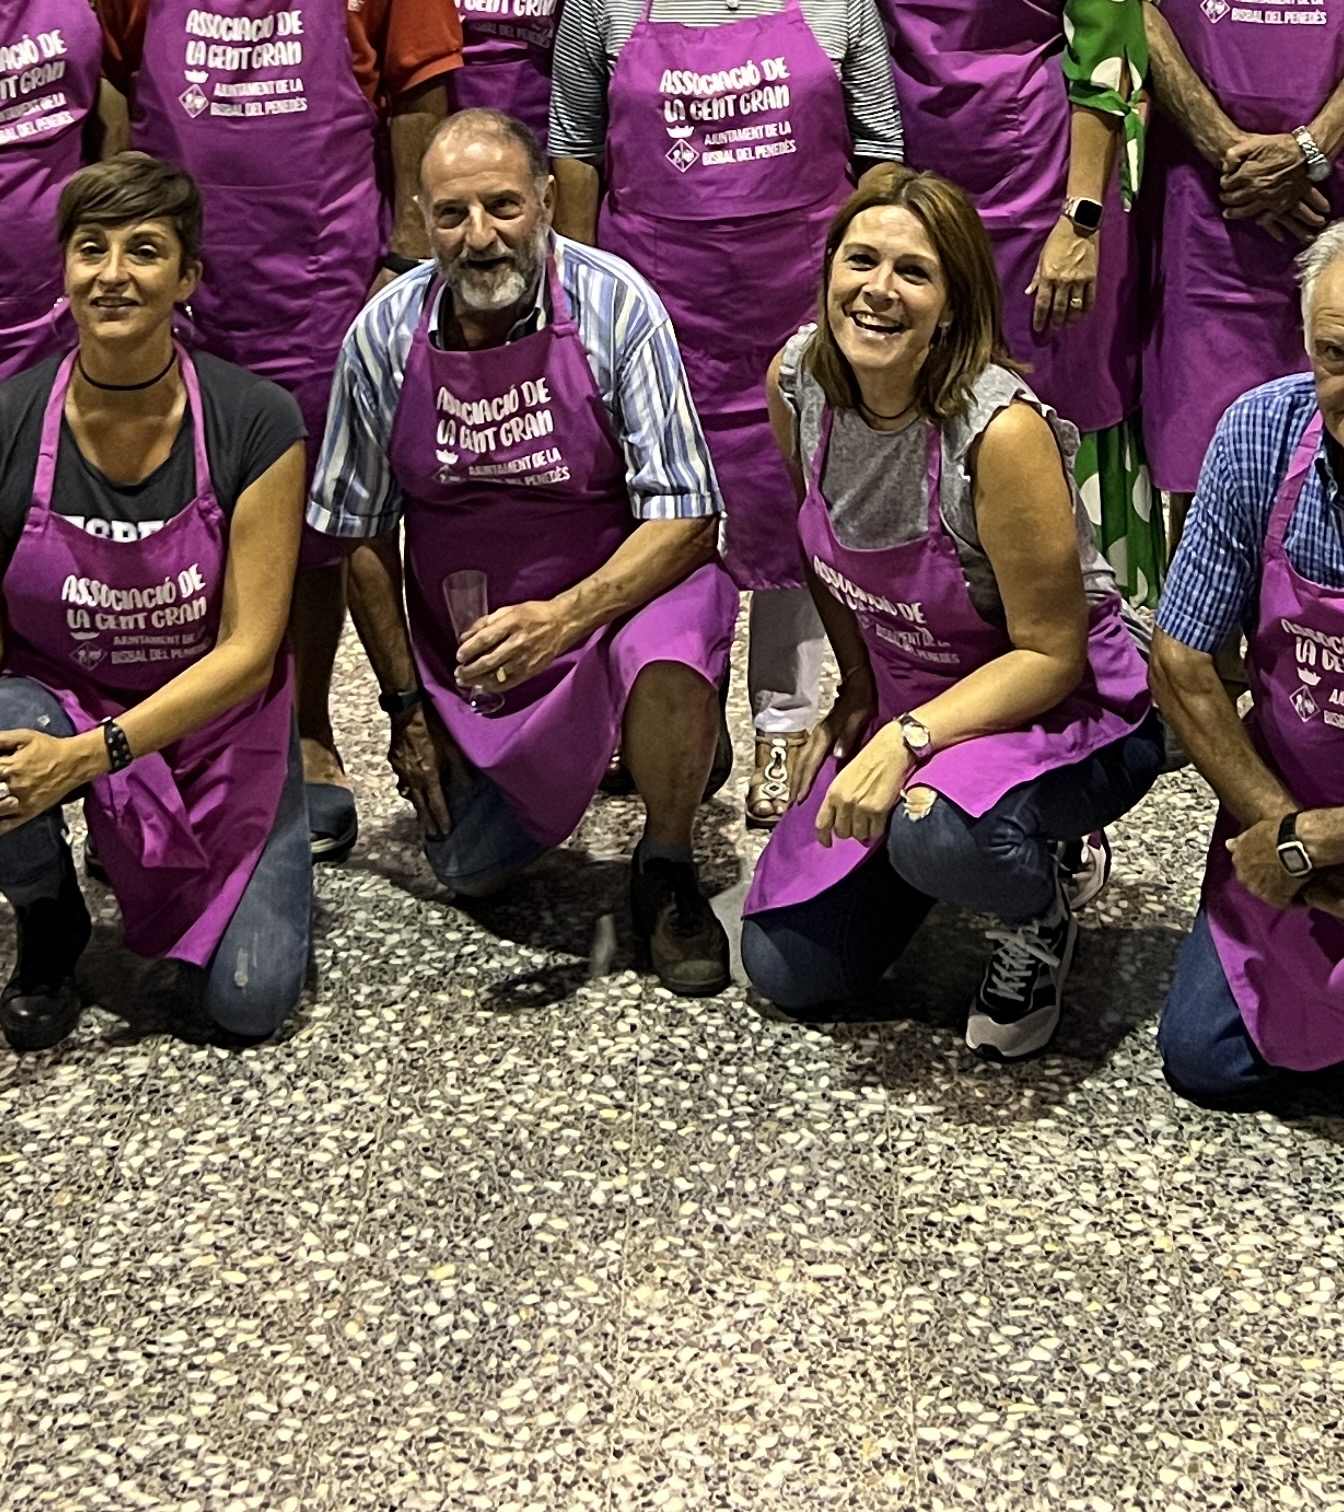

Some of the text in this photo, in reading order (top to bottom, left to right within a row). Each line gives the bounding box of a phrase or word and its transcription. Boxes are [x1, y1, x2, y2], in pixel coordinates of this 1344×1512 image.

[185, 9, 304, 42] ASSOCIACIÓ DE
[1264, 10, 1285, 25] DEL
[36, 29, 68, 59] DE
[185, 41, 302, 71] LA GENT GRAN
[19, 61, 66, 94] GRAN
[275, 79, 290, 94] DE
[289, 78, 304, 93] LA
[659, 57, 791, 95] ASSOCIACIÓ DE
[664, 84, 790, 123] LA GENT GRAN
[704, 121, 792, 146] AJUNTAMENT DE LA
[735, 146, 756, 163] DEL
[520, 377, 552, 407] DE
[436, 419, 456, 446] LA
[499, 409, 554, 447] GRAN
[531, 450, 548, 468] DE
[545, 447, 562, 464] LA
[61, 563, 206, 612] ASSOCIACIÓ DE
[67, 596, 207, 630] LA GENT GRAN
[896, 602, 927, 624] DE
[1295, 636, 1317, 666] LA
